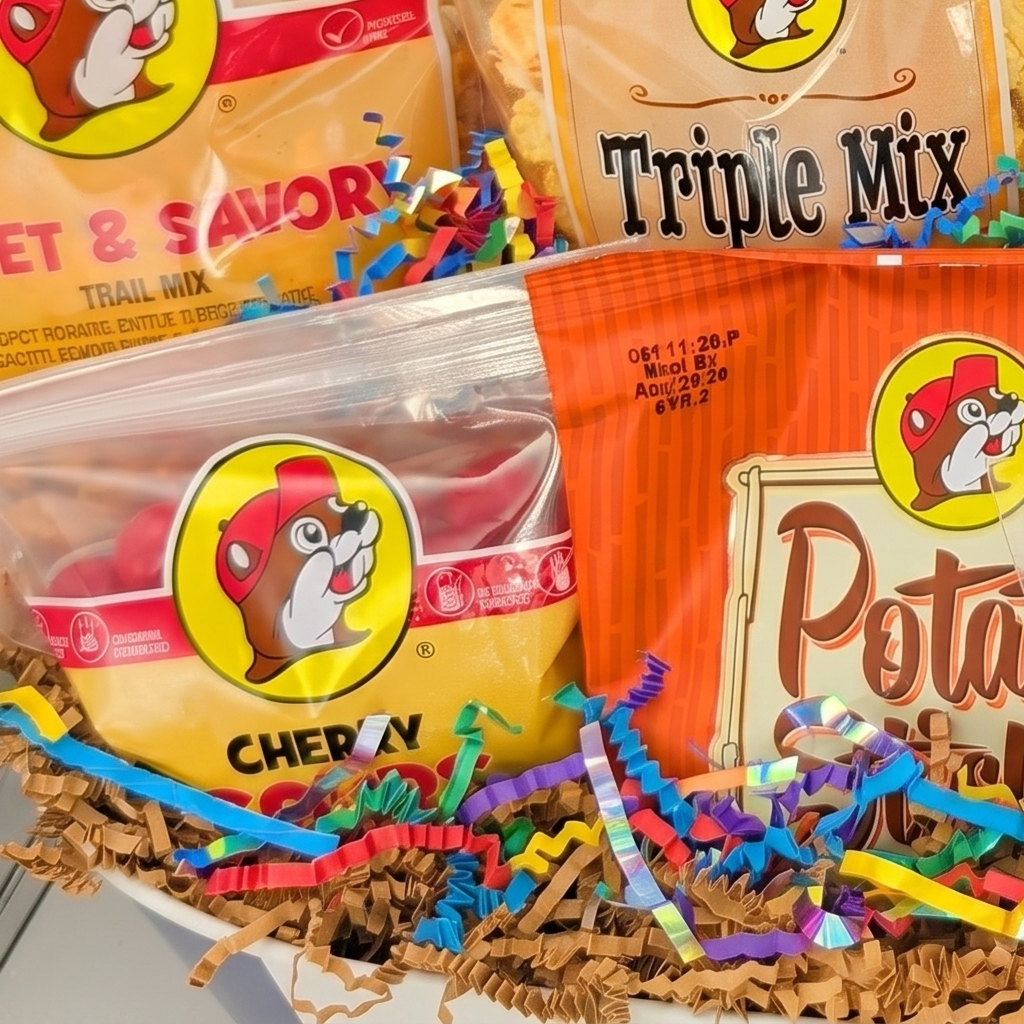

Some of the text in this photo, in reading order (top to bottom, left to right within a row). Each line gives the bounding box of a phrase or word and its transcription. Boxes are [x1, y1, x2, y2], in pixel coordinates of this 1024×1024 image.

[598, 109, 971, 248] Triple Mix
[88, 209, 138, 263] &
[80, 278, 156, 310] TRAIL
[160, 268, 212, 300] MIX
